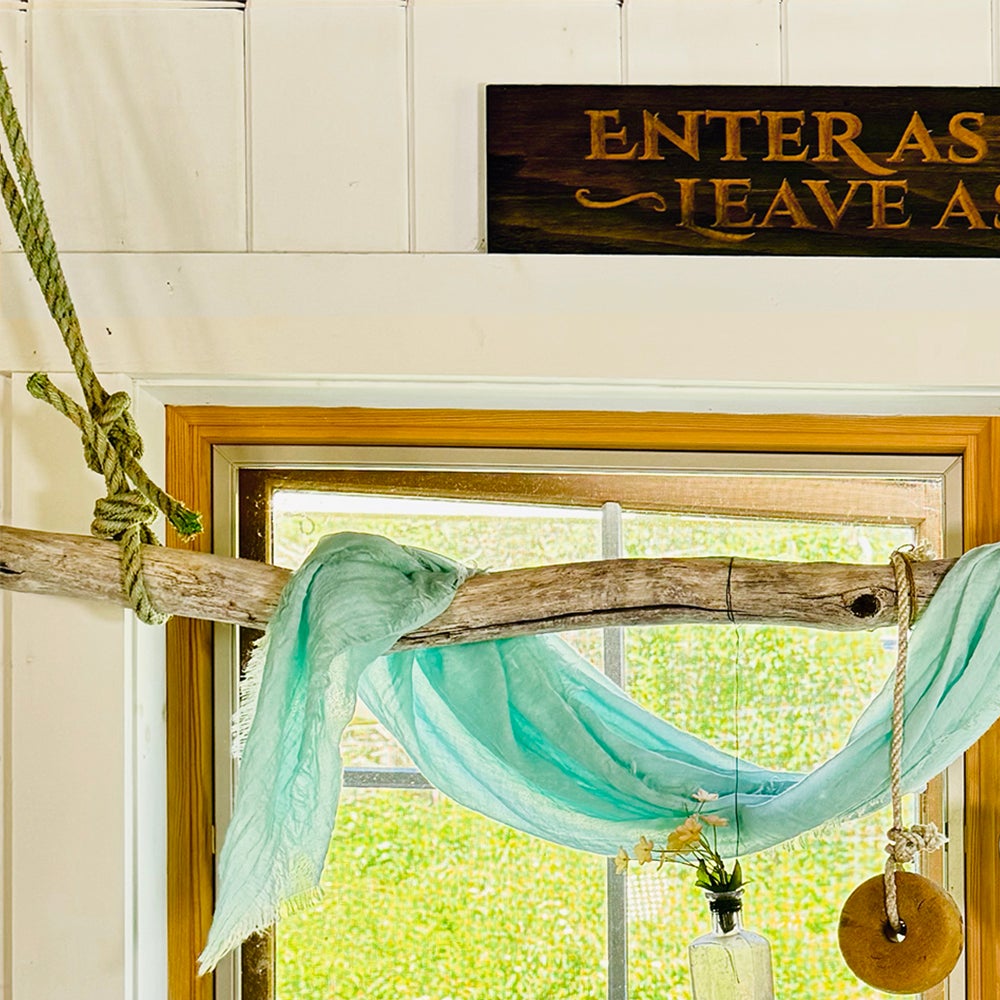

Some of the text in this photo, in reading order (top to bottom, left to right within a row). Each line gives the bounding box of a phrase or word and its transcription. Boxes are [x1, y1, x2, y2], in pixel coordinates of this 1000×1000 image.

[584, 109, 897, 176] ENTER
[886, 111, 988, 164] AS
[674, 178, 910, 242] LEAVE
